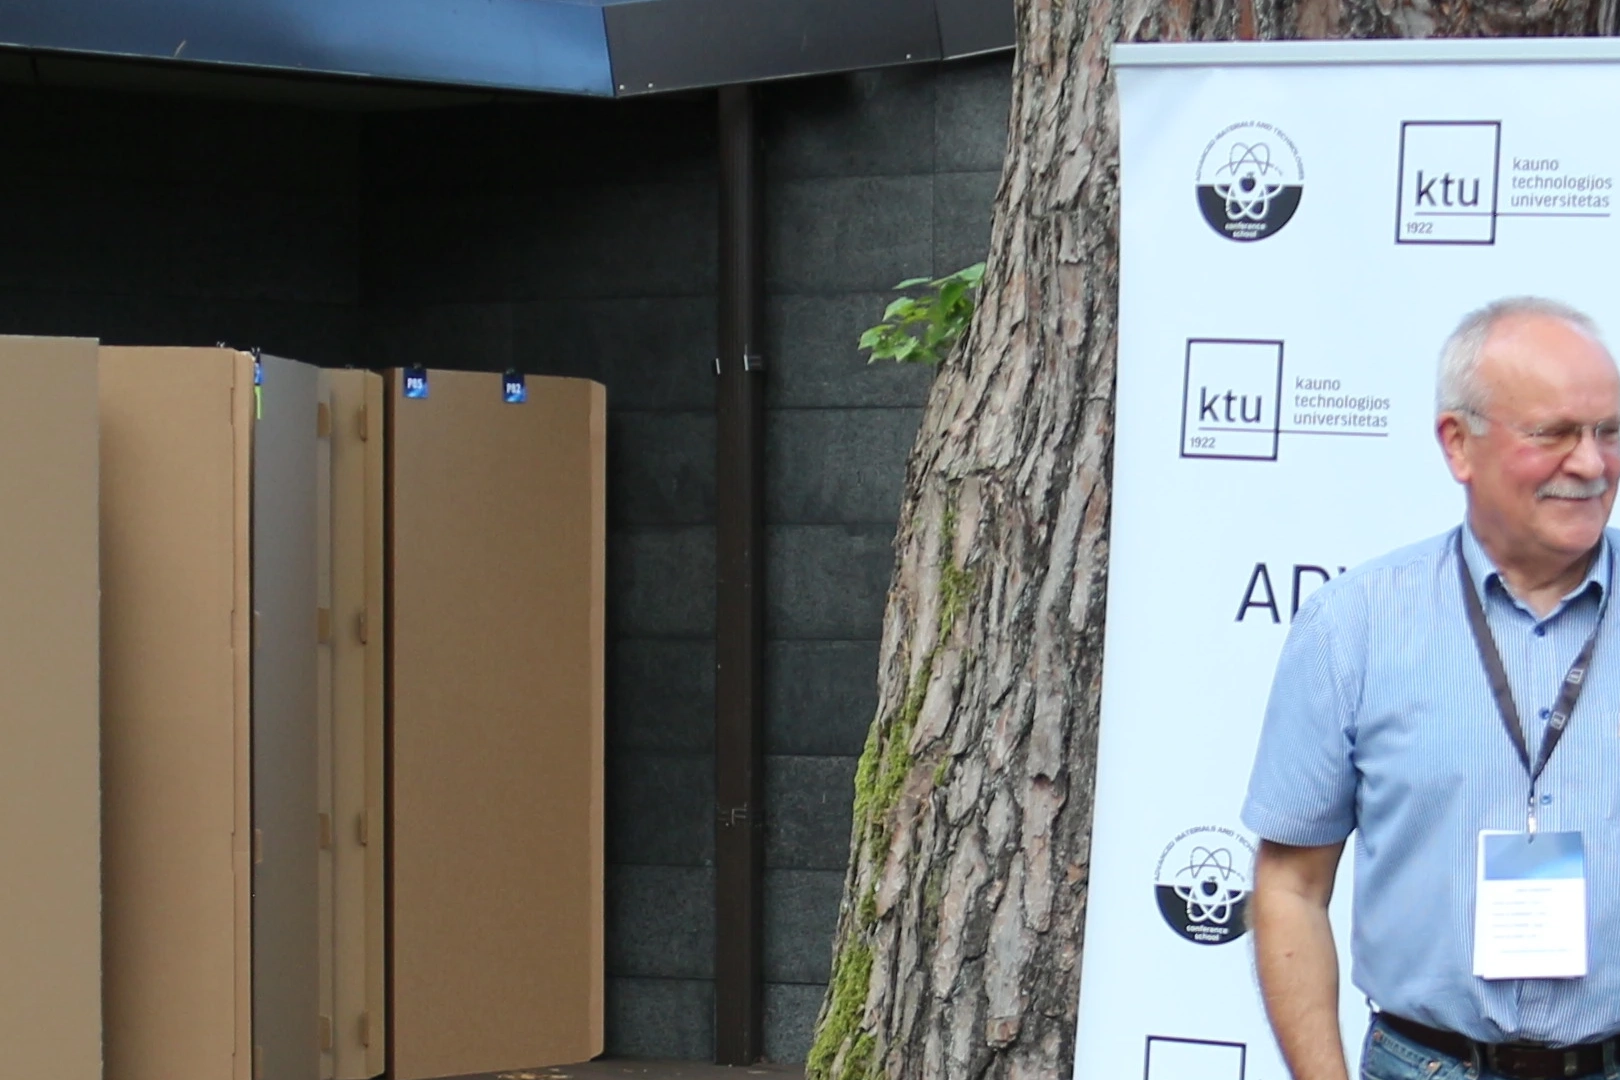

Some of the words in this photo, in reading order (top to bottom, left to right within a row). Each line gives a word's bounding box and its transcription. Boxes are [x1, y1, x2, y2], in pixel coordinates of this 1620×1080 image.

[1512, 156, 1559, 171] kauno
[1415, 170, 1479, 207] ktu
[1511, 175, 1613, 191] technologijos
[1510, 193, 1610, 208] universitetas
[1406, 221, 1434, 234] 1922
[1295, 376, 1341, 391] kauno
[1199, 386, 1262, 423] ktu
[1294, 394, 1391, 411] technologijos
[1293, 411, 1389, 428] universitetas
[1189, 436, 1216, 449] 1922
[1234, 562, 1346, 625] AD
